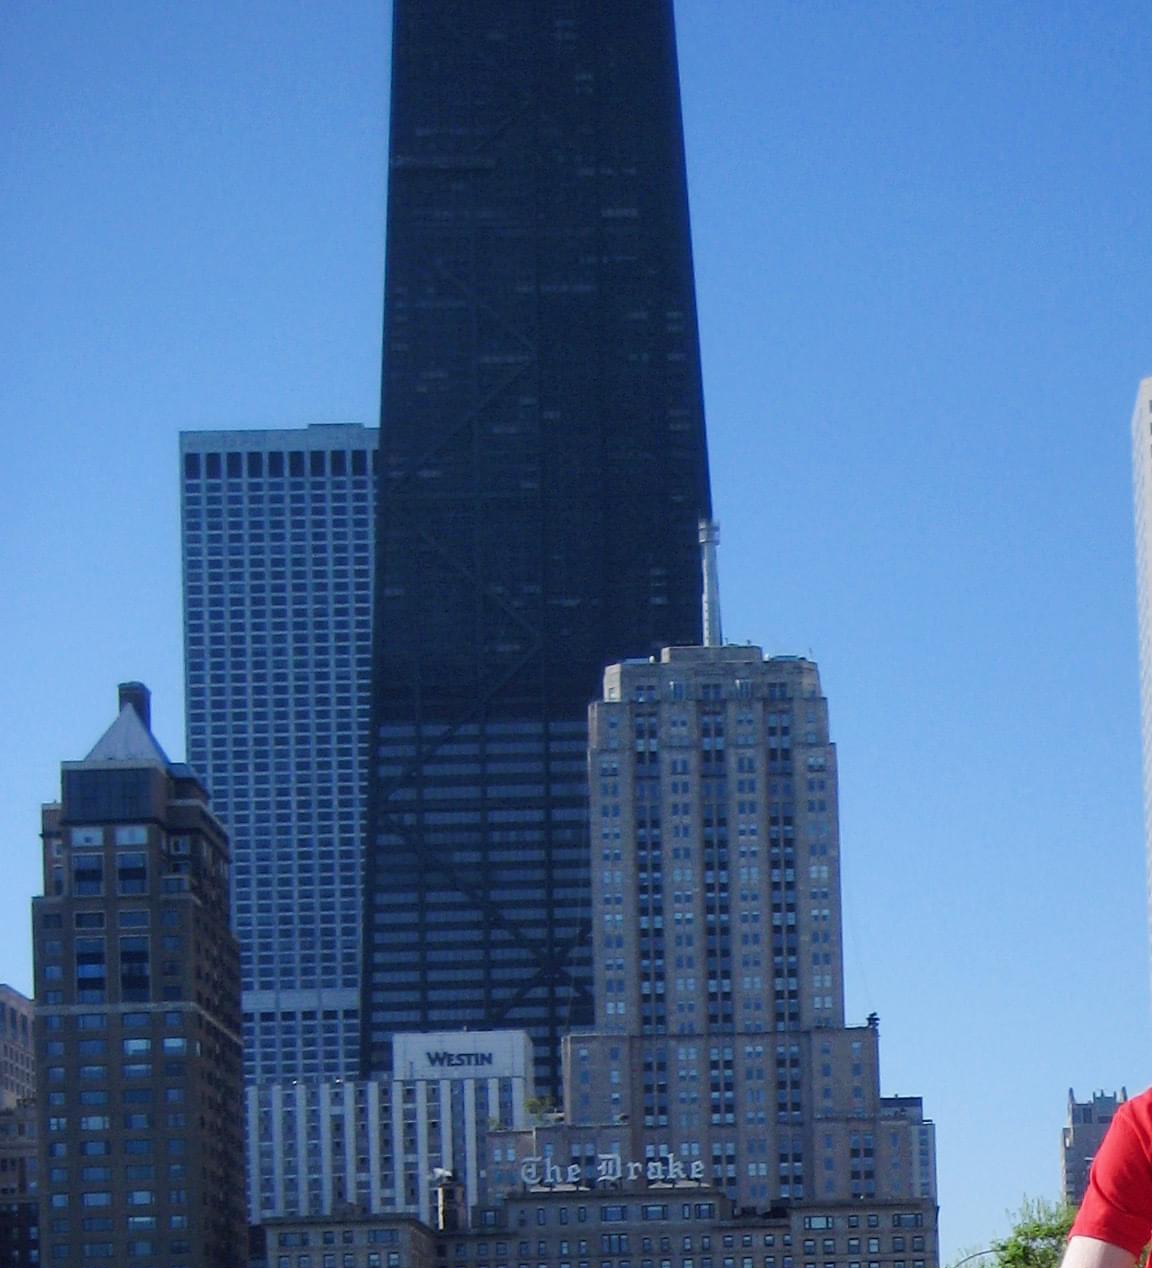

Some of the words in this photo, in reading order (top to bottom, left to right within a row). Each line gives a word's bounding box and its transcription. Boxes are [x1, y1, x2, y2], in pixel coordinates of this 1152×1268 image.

[426, 1052, 492, 1067] WESTIN
[521, 1156, 582, 1185] The
[597, 1153, 704, 1182] Drake
